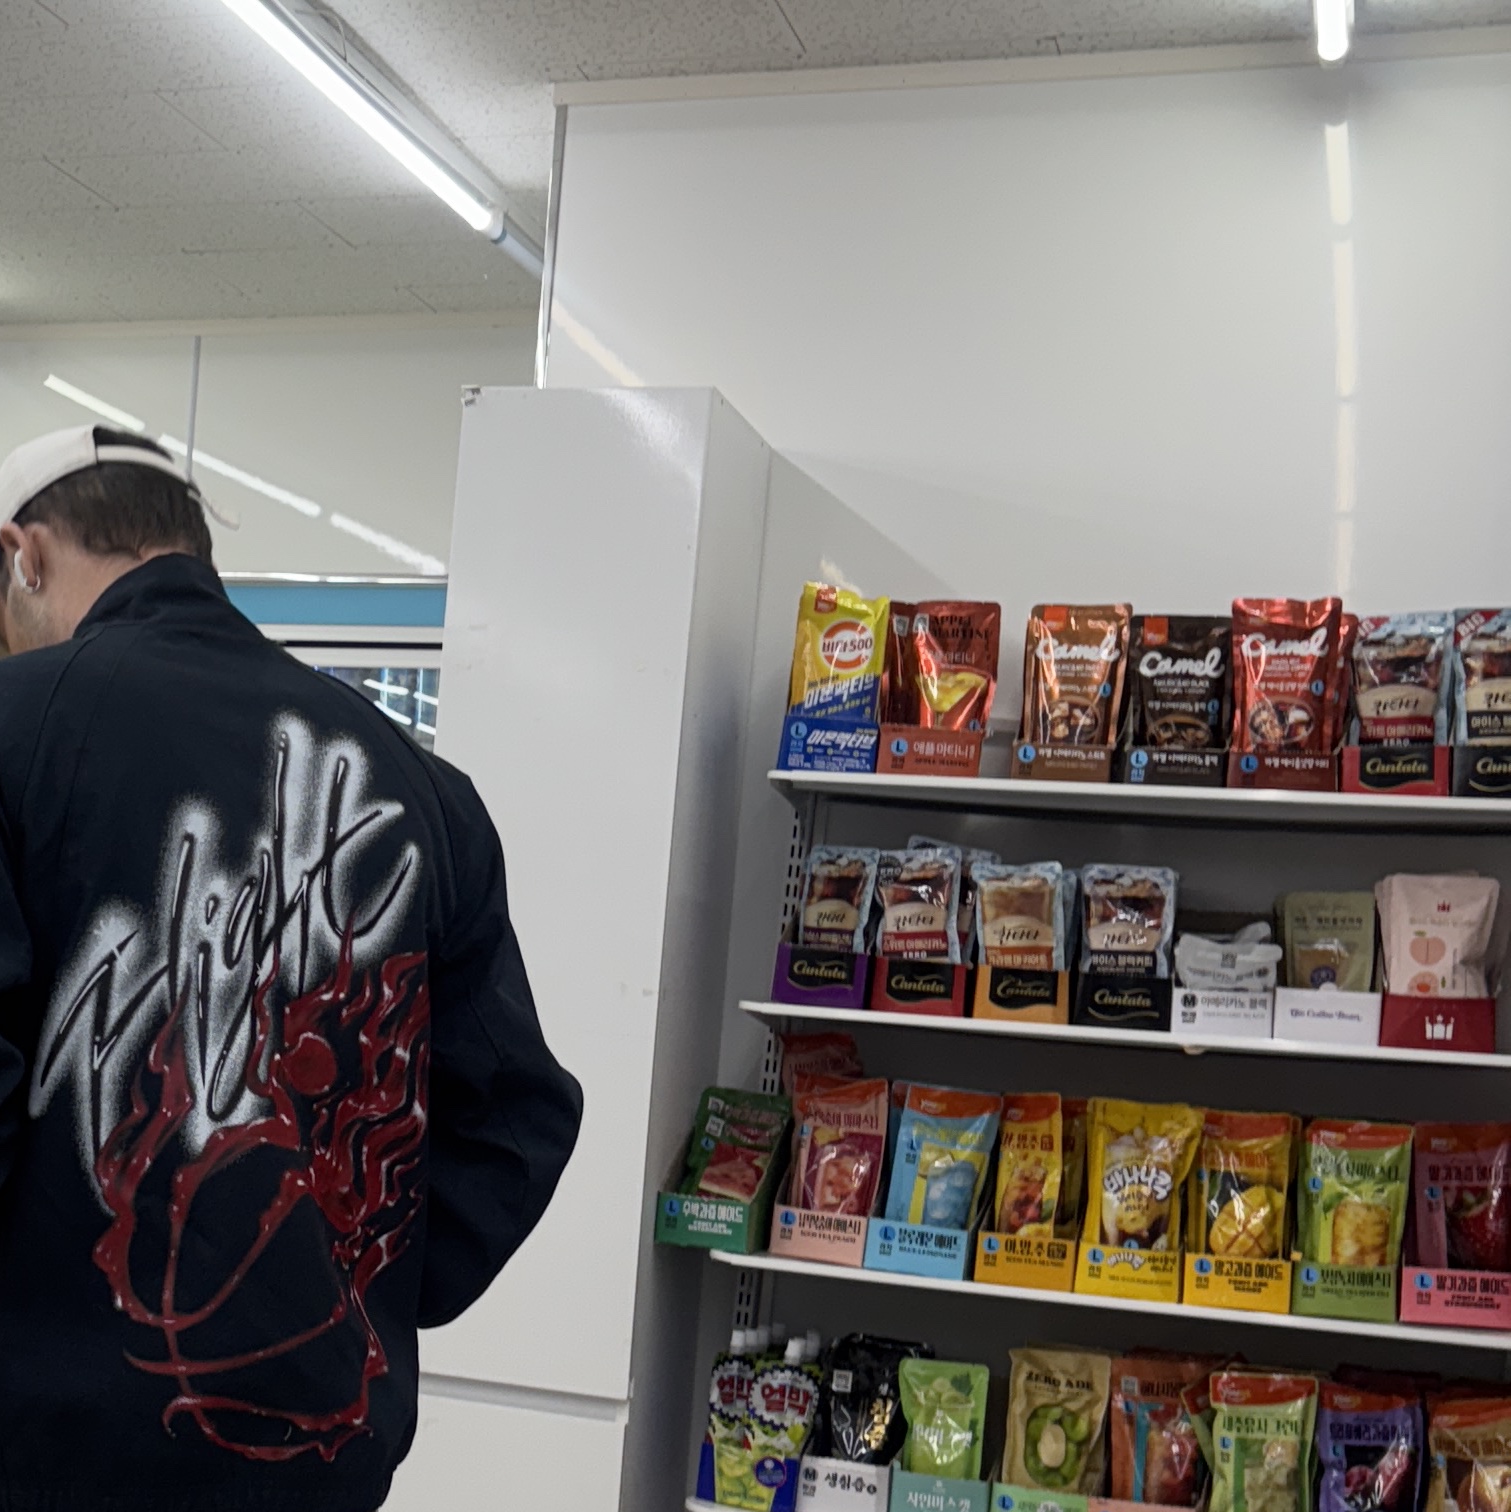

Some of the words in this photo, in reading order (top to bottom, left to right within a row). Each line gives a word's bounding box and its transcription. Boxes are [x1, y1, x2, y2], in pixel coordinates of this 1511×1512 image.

[821, 638, 873, 653] 비타500
[1036, 628, 1121, 662] Camel
[1242, 629, 1330, 660] Camel
[1139, 648, 1225, 678] Camel
[1365, 756, 1429, 775] Cantata
[793, 959, 848, 981] Cantata
[891, 973, 947, 995] Cantata
[1094, 990, 1152, 1008] Cantata
